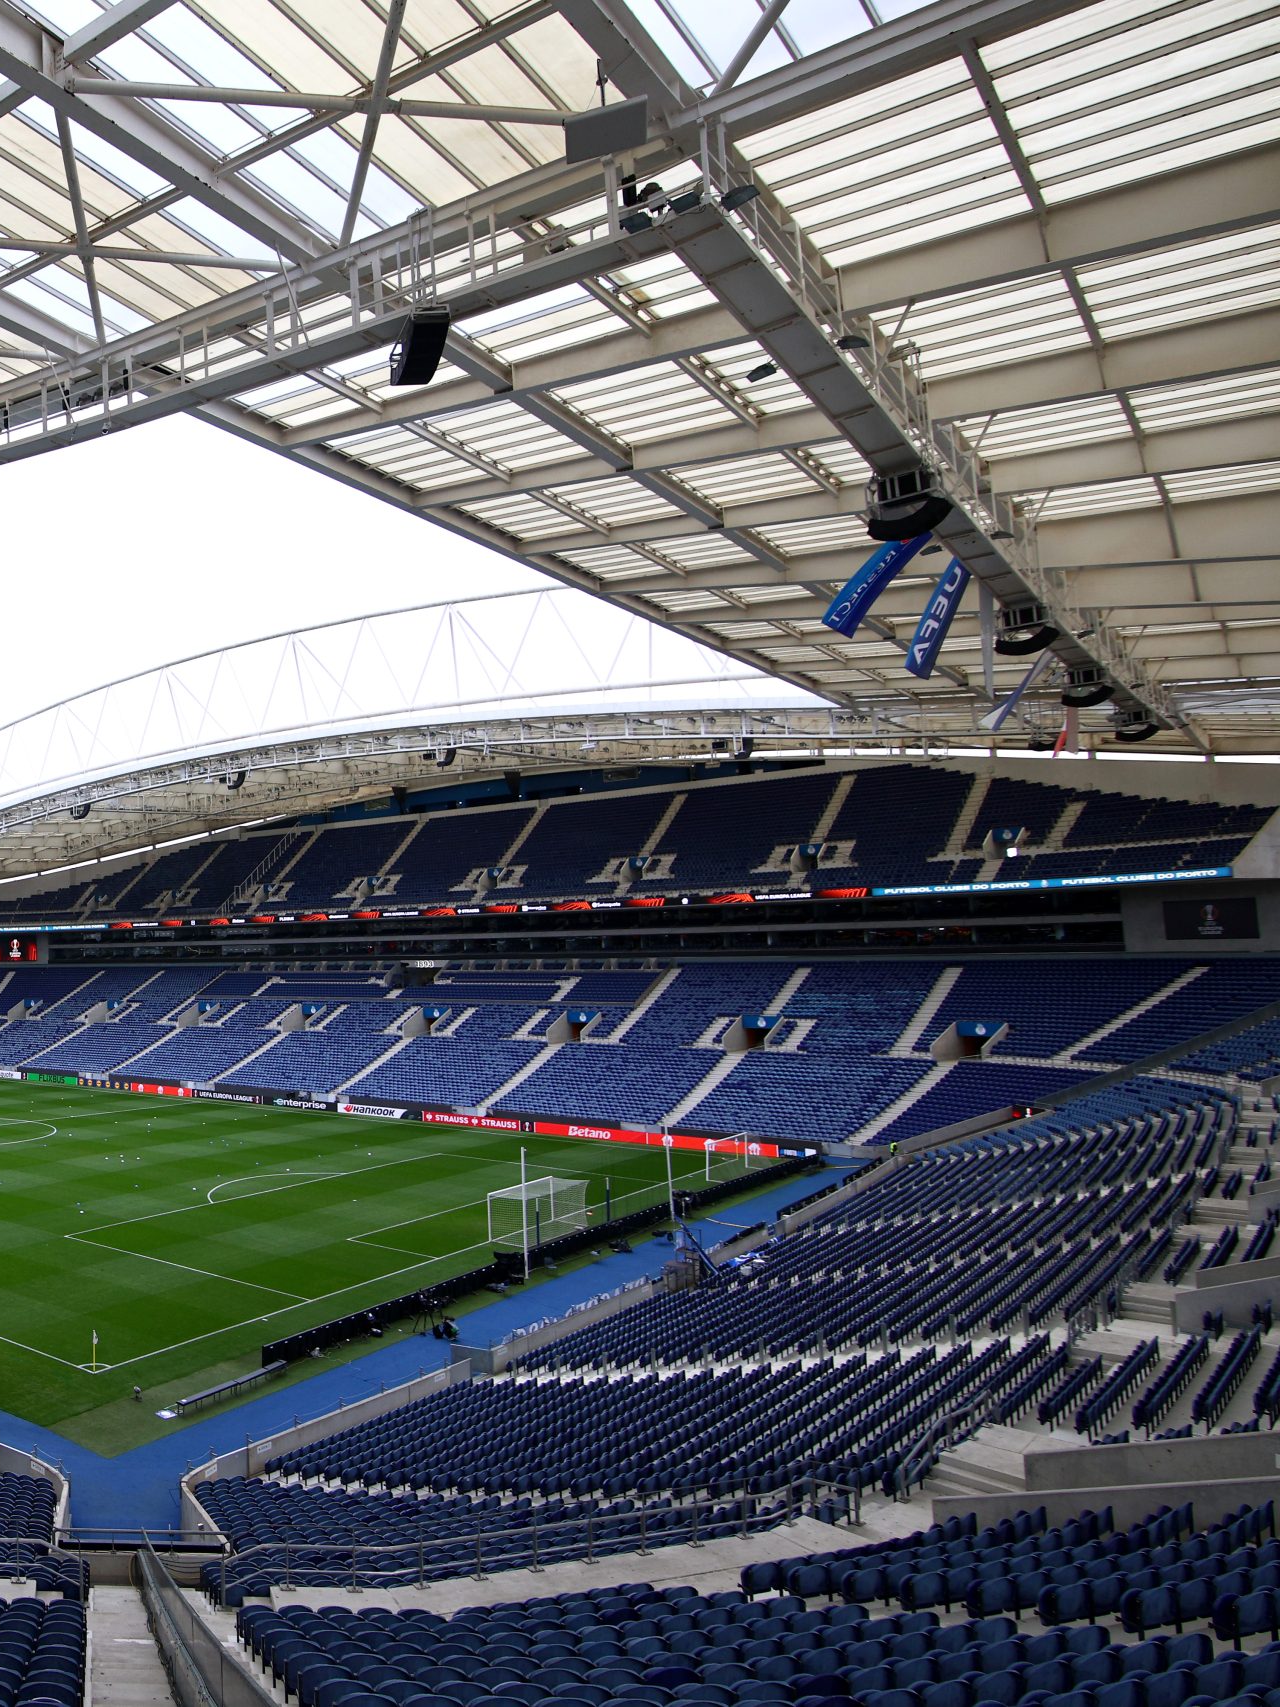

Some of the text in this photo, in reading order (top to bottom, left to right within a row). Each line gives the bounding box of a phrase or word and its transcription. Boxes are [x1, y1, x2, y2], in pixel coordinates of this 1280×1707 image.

[1062, 869, 1217, 886] FUTEBOL CLUBE DO PORTO
[884, 886, 932, 894] FUTEBOL
[934, 884, 970, 892] CLUBE
[990, 881, 1030, 889] PORTO
[213, 1092, 232, 1100] EUROPA
[233, 1094, 254, 1102] LEAGUE
[273, 1097, 327, 1110] enterprise
[435, 1114, 517, 1129] STRAUSS STRAUSS
[568, 1125, 611, 1140] Betano
